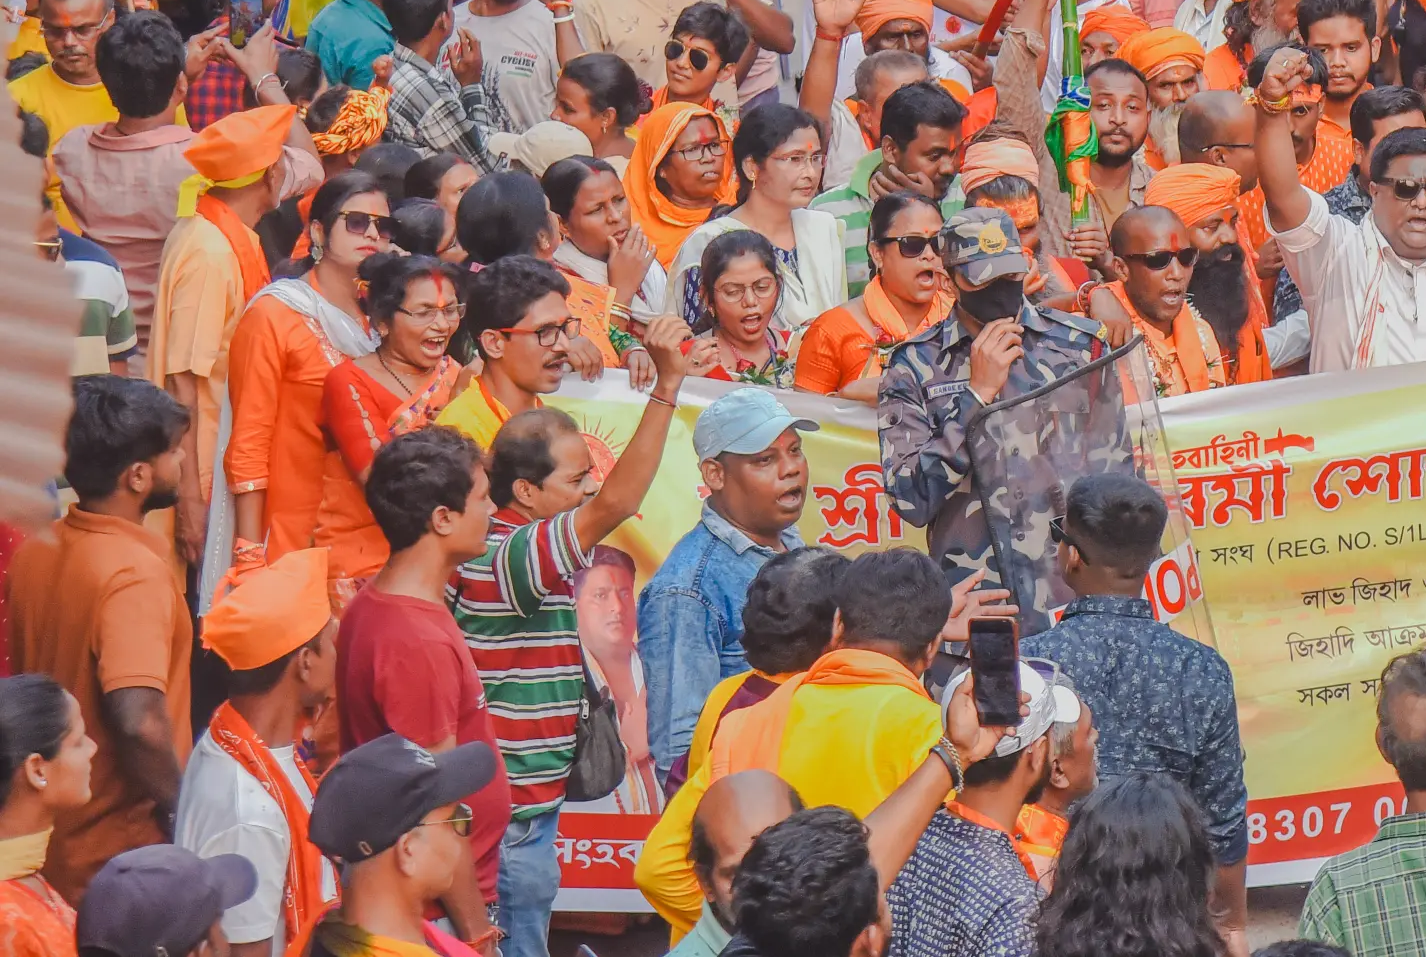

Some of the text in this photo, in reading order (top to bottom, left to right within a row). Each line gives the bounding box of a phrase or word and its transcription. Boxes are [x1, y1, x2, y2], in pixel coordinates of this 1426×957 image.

[1267, 536, 1330, 565] (REG.
[1338, 530, 1377, 553] NO.
[1301, 587, 1346, 610] লাভ
[1350, 577, 1412, 605] জিহাদ
[1286, 625, 1355, 662] জিহাদি
[1297, 682, 1351, 707] সকল
